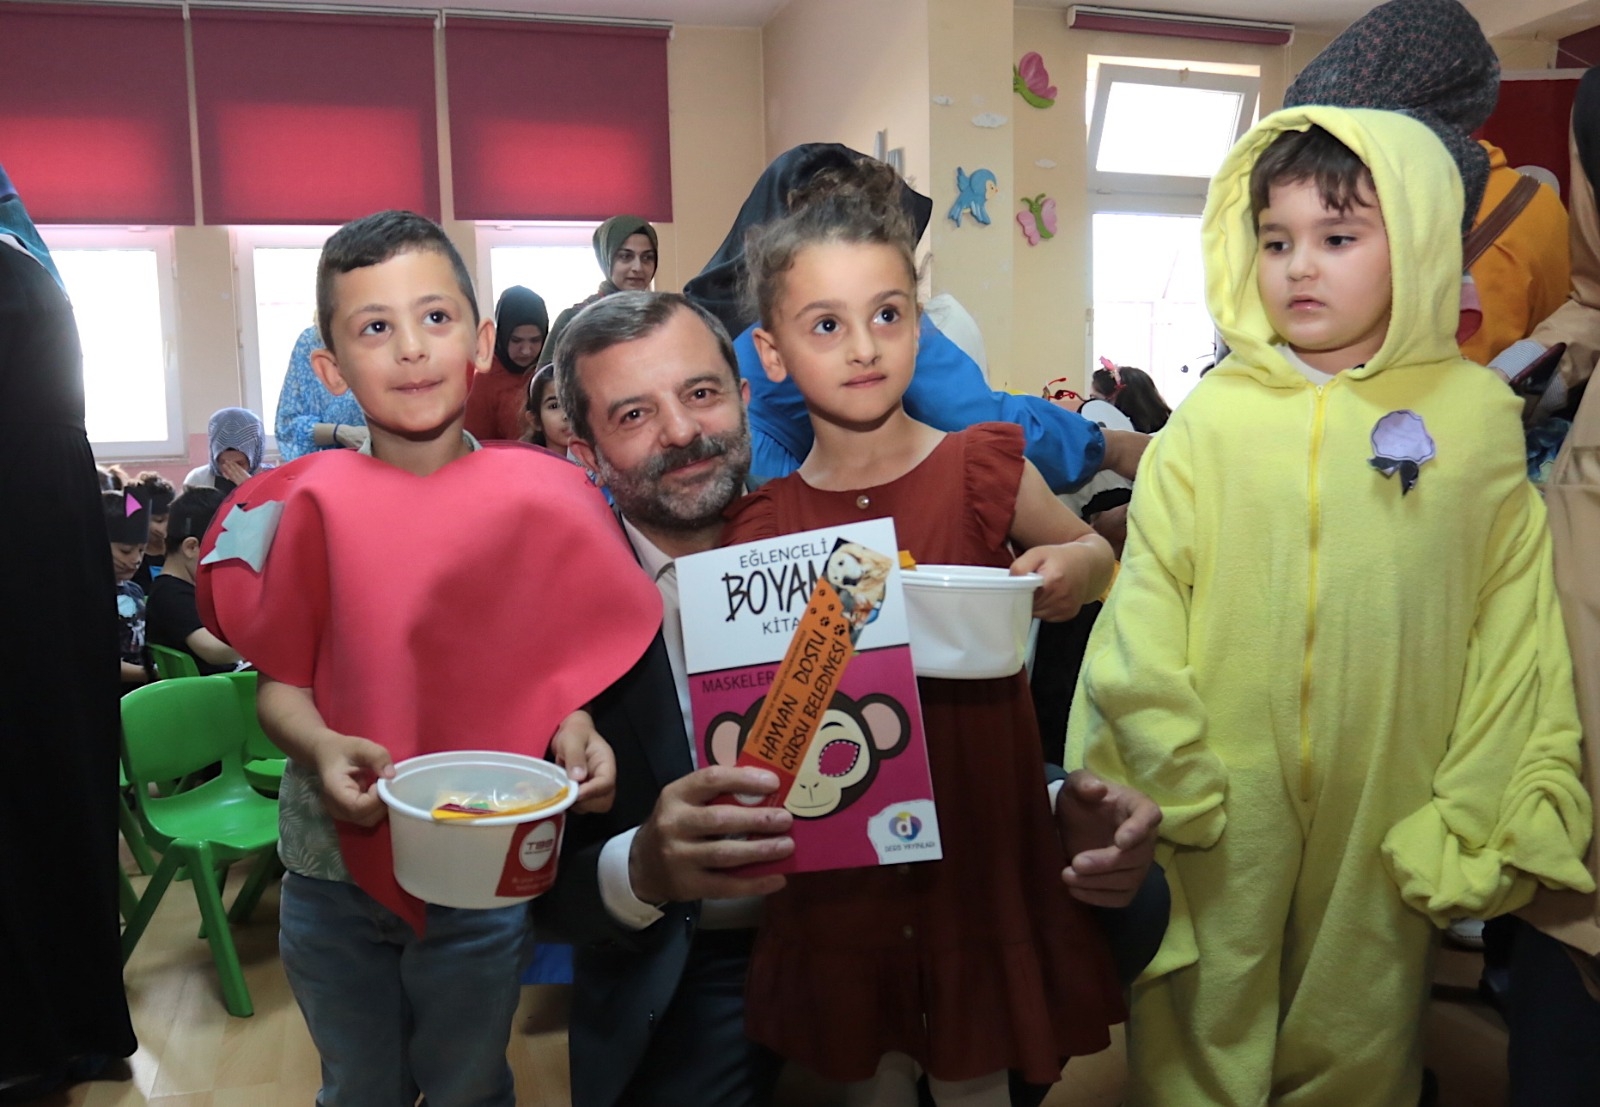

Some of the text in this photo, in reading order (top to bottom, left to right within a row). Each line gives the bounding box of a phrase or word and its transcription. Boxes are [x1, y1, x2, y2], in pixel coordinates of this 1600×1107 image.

[739, 537, 828, 569] EĞLENCELİ
[702, 670, 775, 694] MASKELER
[759, 694, 799, 761] HAYVAN
[793, 629, 827, 685] DOSTU
[780, 639, 848, 770] GÜRSU BELEDİYESİ
